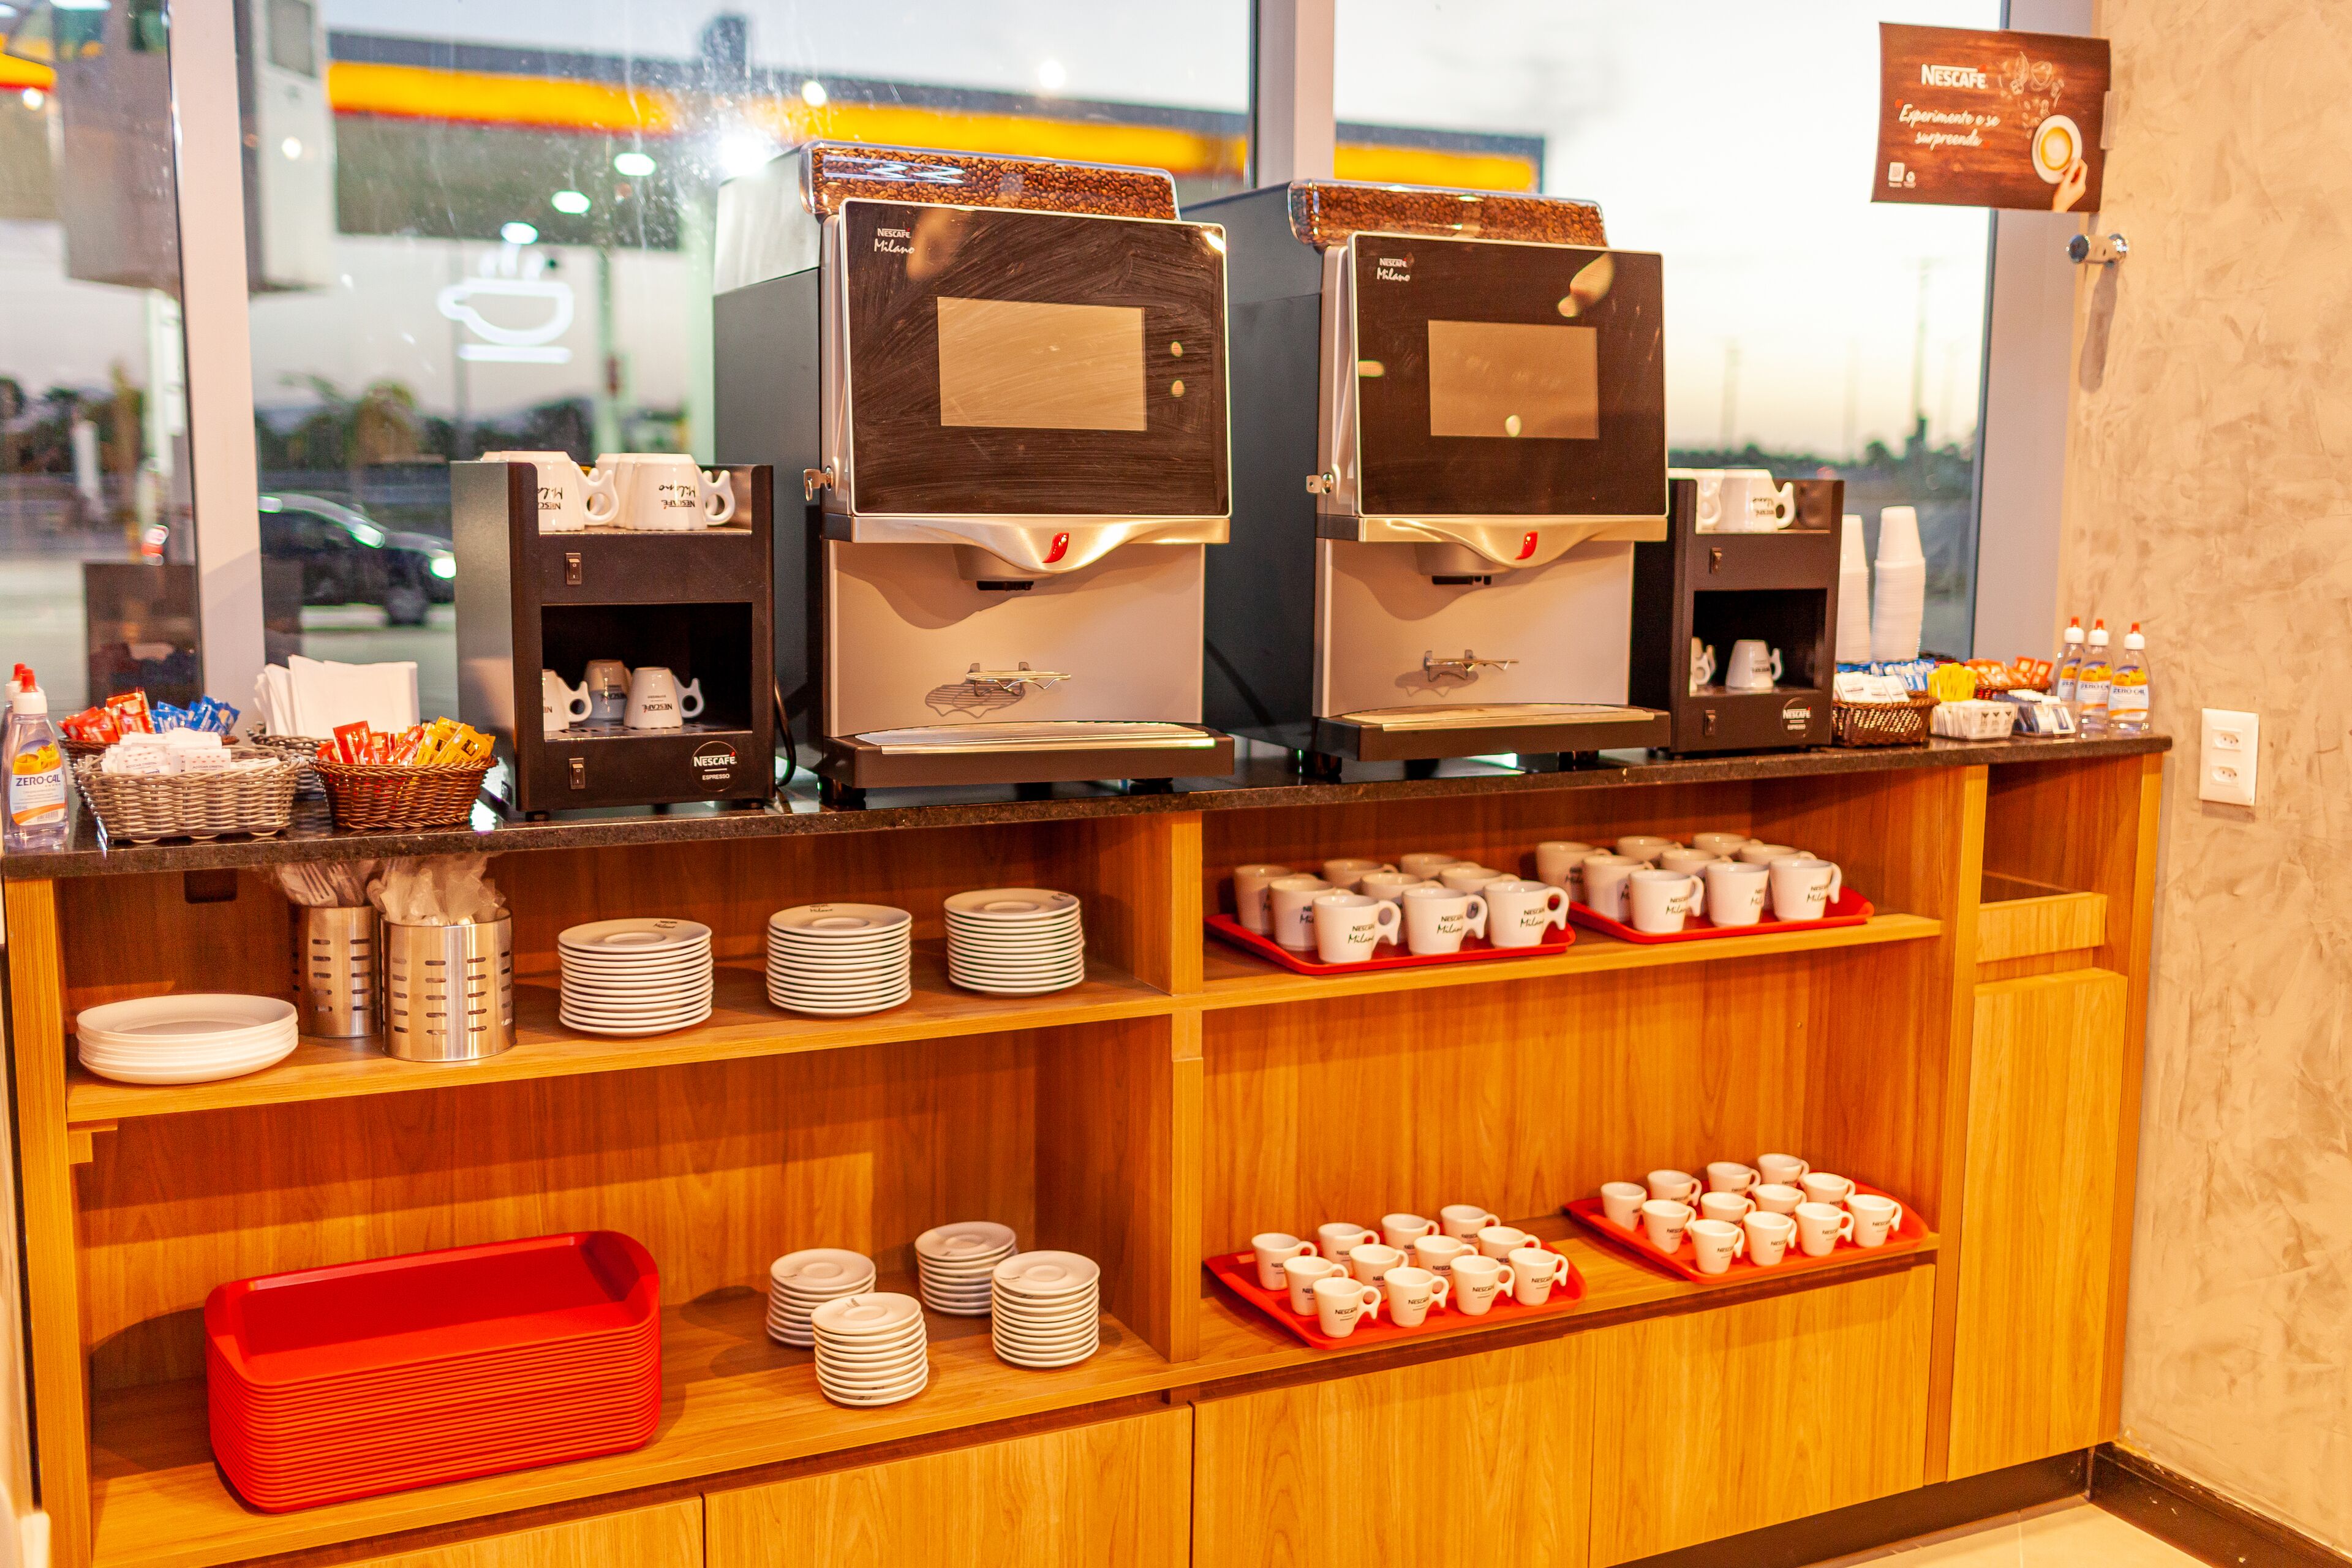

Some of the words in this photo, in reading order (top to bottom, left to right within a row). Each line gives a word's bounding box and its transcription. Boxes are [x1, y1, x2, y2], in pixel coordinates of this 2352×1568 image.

[1899, 104, 1975, 128] Experimente
[1975, 115, 1985, 126] e
[1986, 115, 2000, 127] se
[1915, 128, 1983, 151] surpreenda
[874, 238, 915, 254] Milano
[1377, 267, 1411, 282] Milano
[538, 487, 562, 499] Mila
[659, 484, 696, 497] Milano
[15, 774, 61, 786] ZERO-CAL
[1520, 916, 1545, 927] Milan
[1437, 924, 1463, 934] Milan
[1348, 933, 1375, 944] Milan
